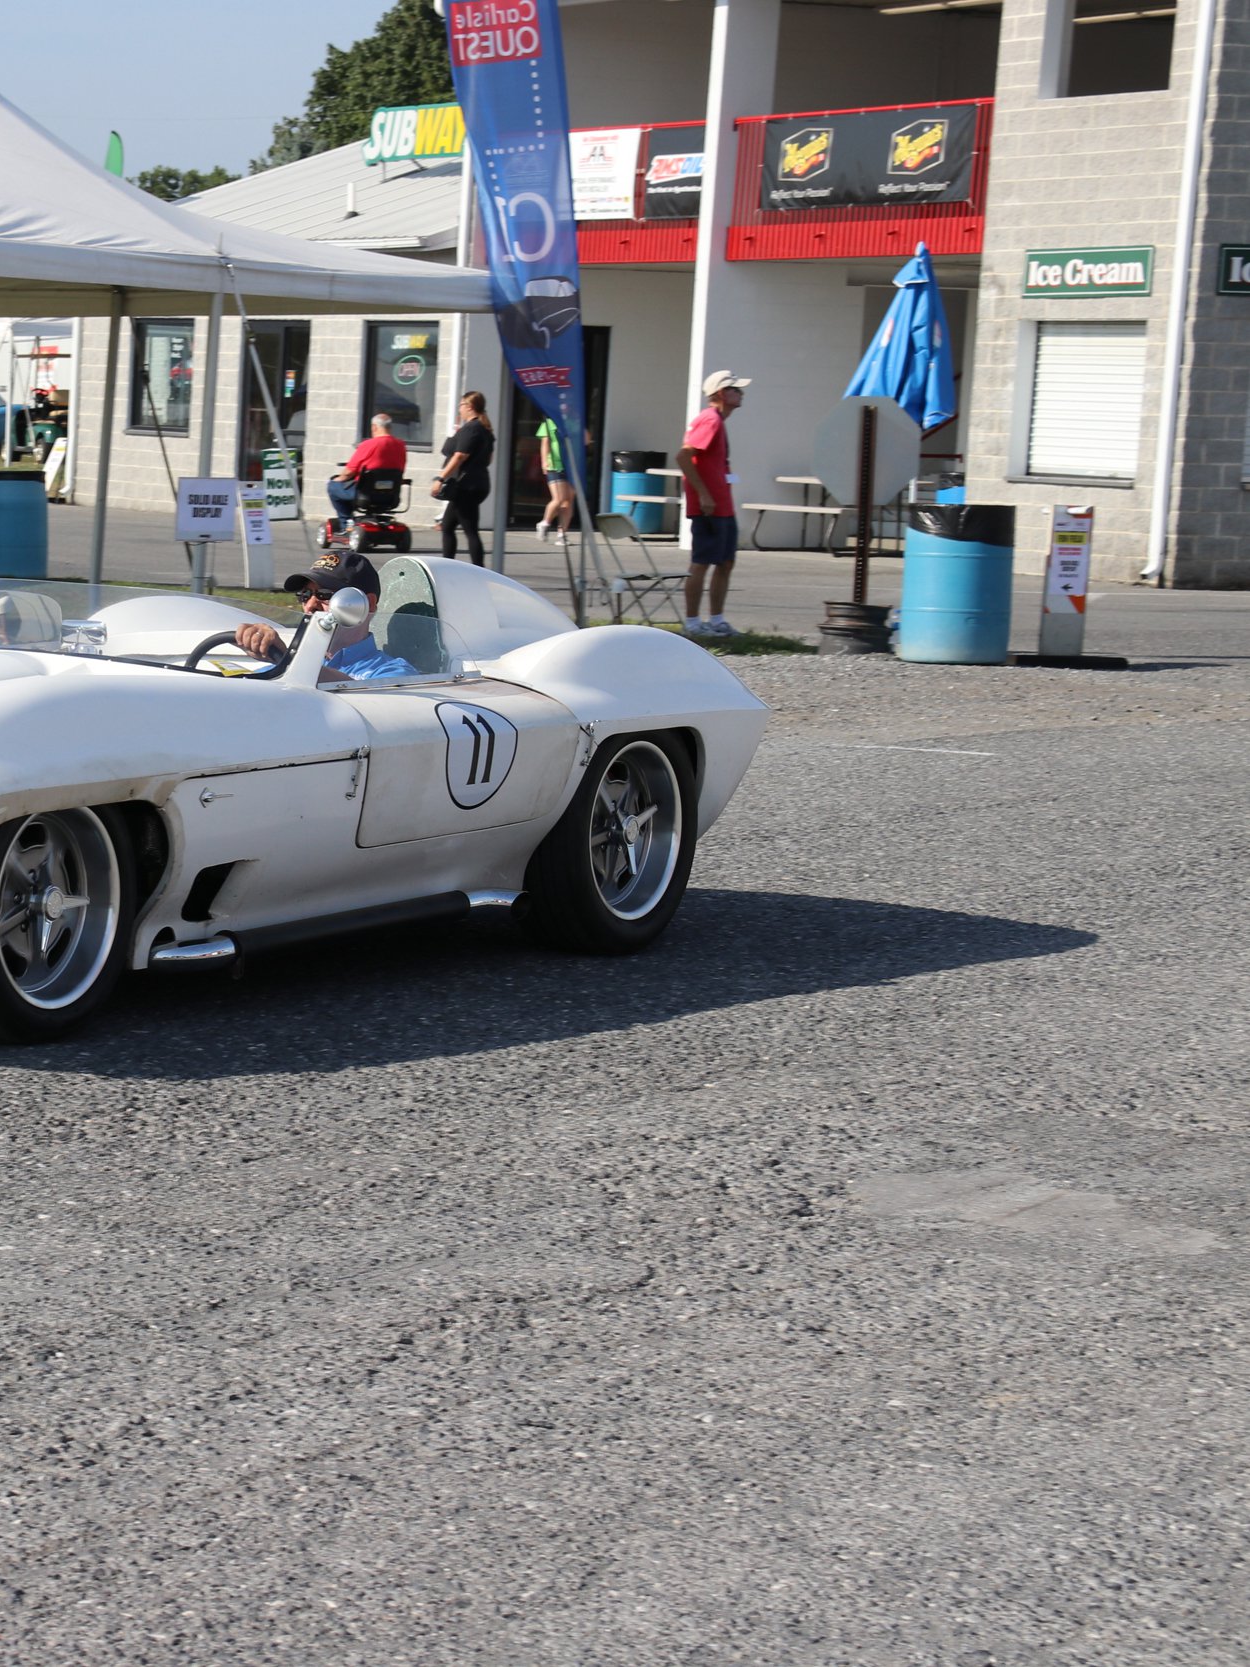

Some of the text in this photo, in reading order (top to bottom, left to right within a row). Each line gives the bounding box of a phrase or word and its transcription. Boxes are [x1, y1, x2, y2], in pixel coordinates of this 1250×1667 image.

[1027, 258, 1145, 287] Ice Cream
[188, 494, 210, 506] SOLID
[211, 494, 229, 506] AXLE
[193, 507, 223, 518] DISPLAY
[461, 712, 496, 786] 11
